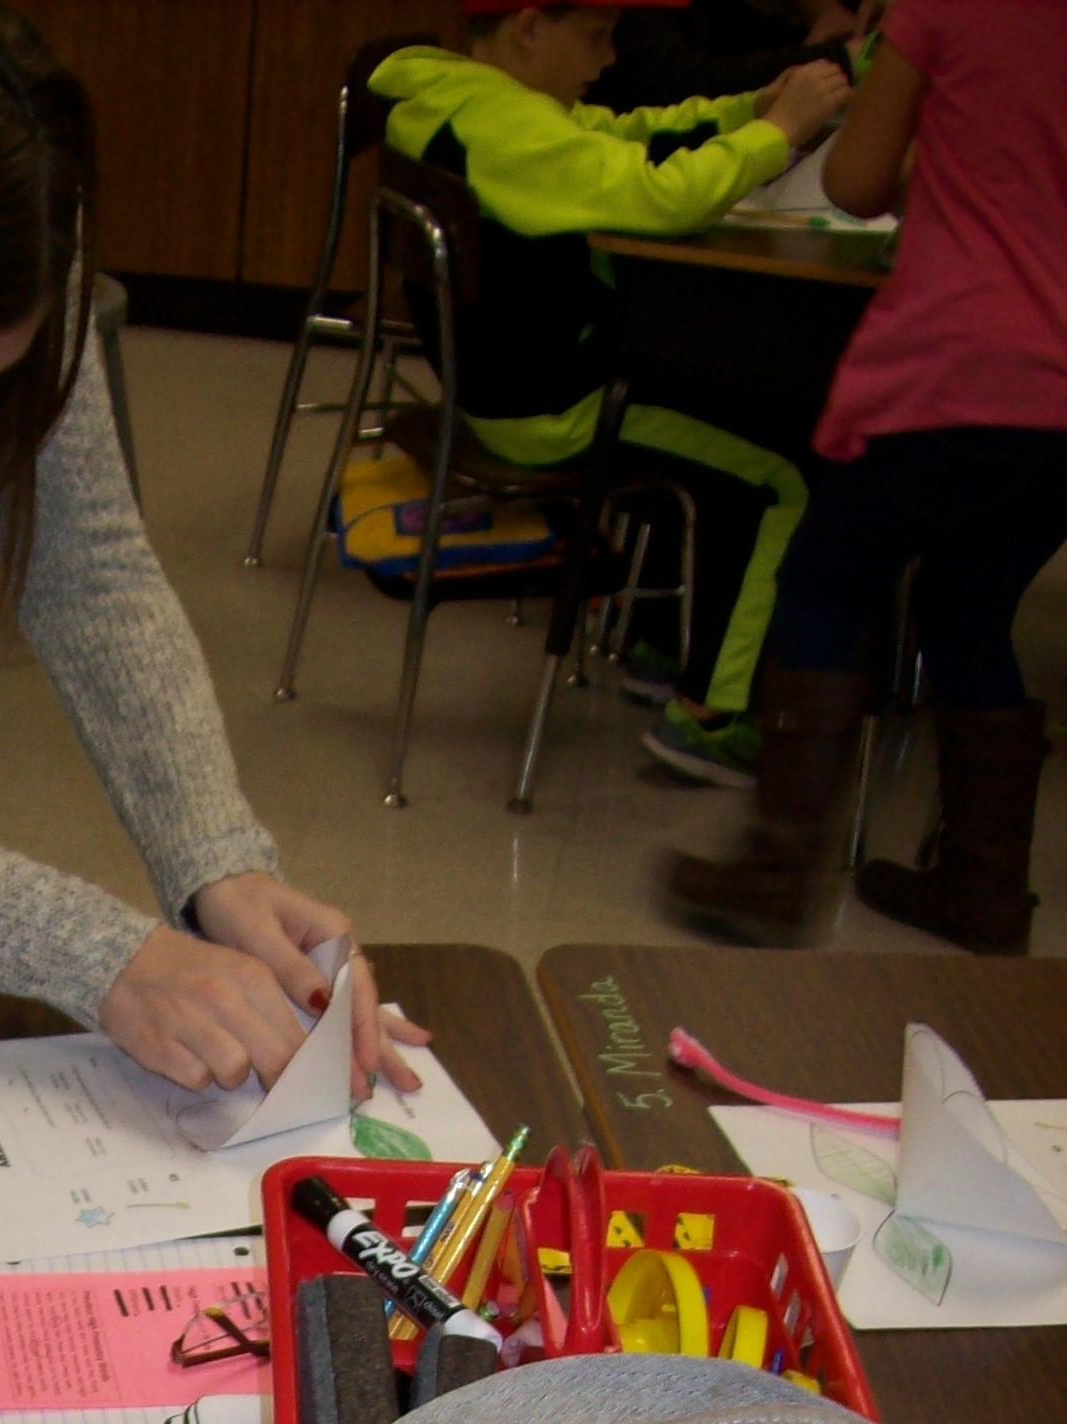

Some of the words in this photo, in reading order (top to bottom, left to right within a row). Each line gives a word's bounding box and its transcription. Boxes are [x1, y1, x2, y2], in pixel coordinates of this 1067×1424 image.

[574, 974, 662, 1078] Miranda
[616, 1088, 674, 1109] 5.
[353, 1230, 420, 1279] EXPO
